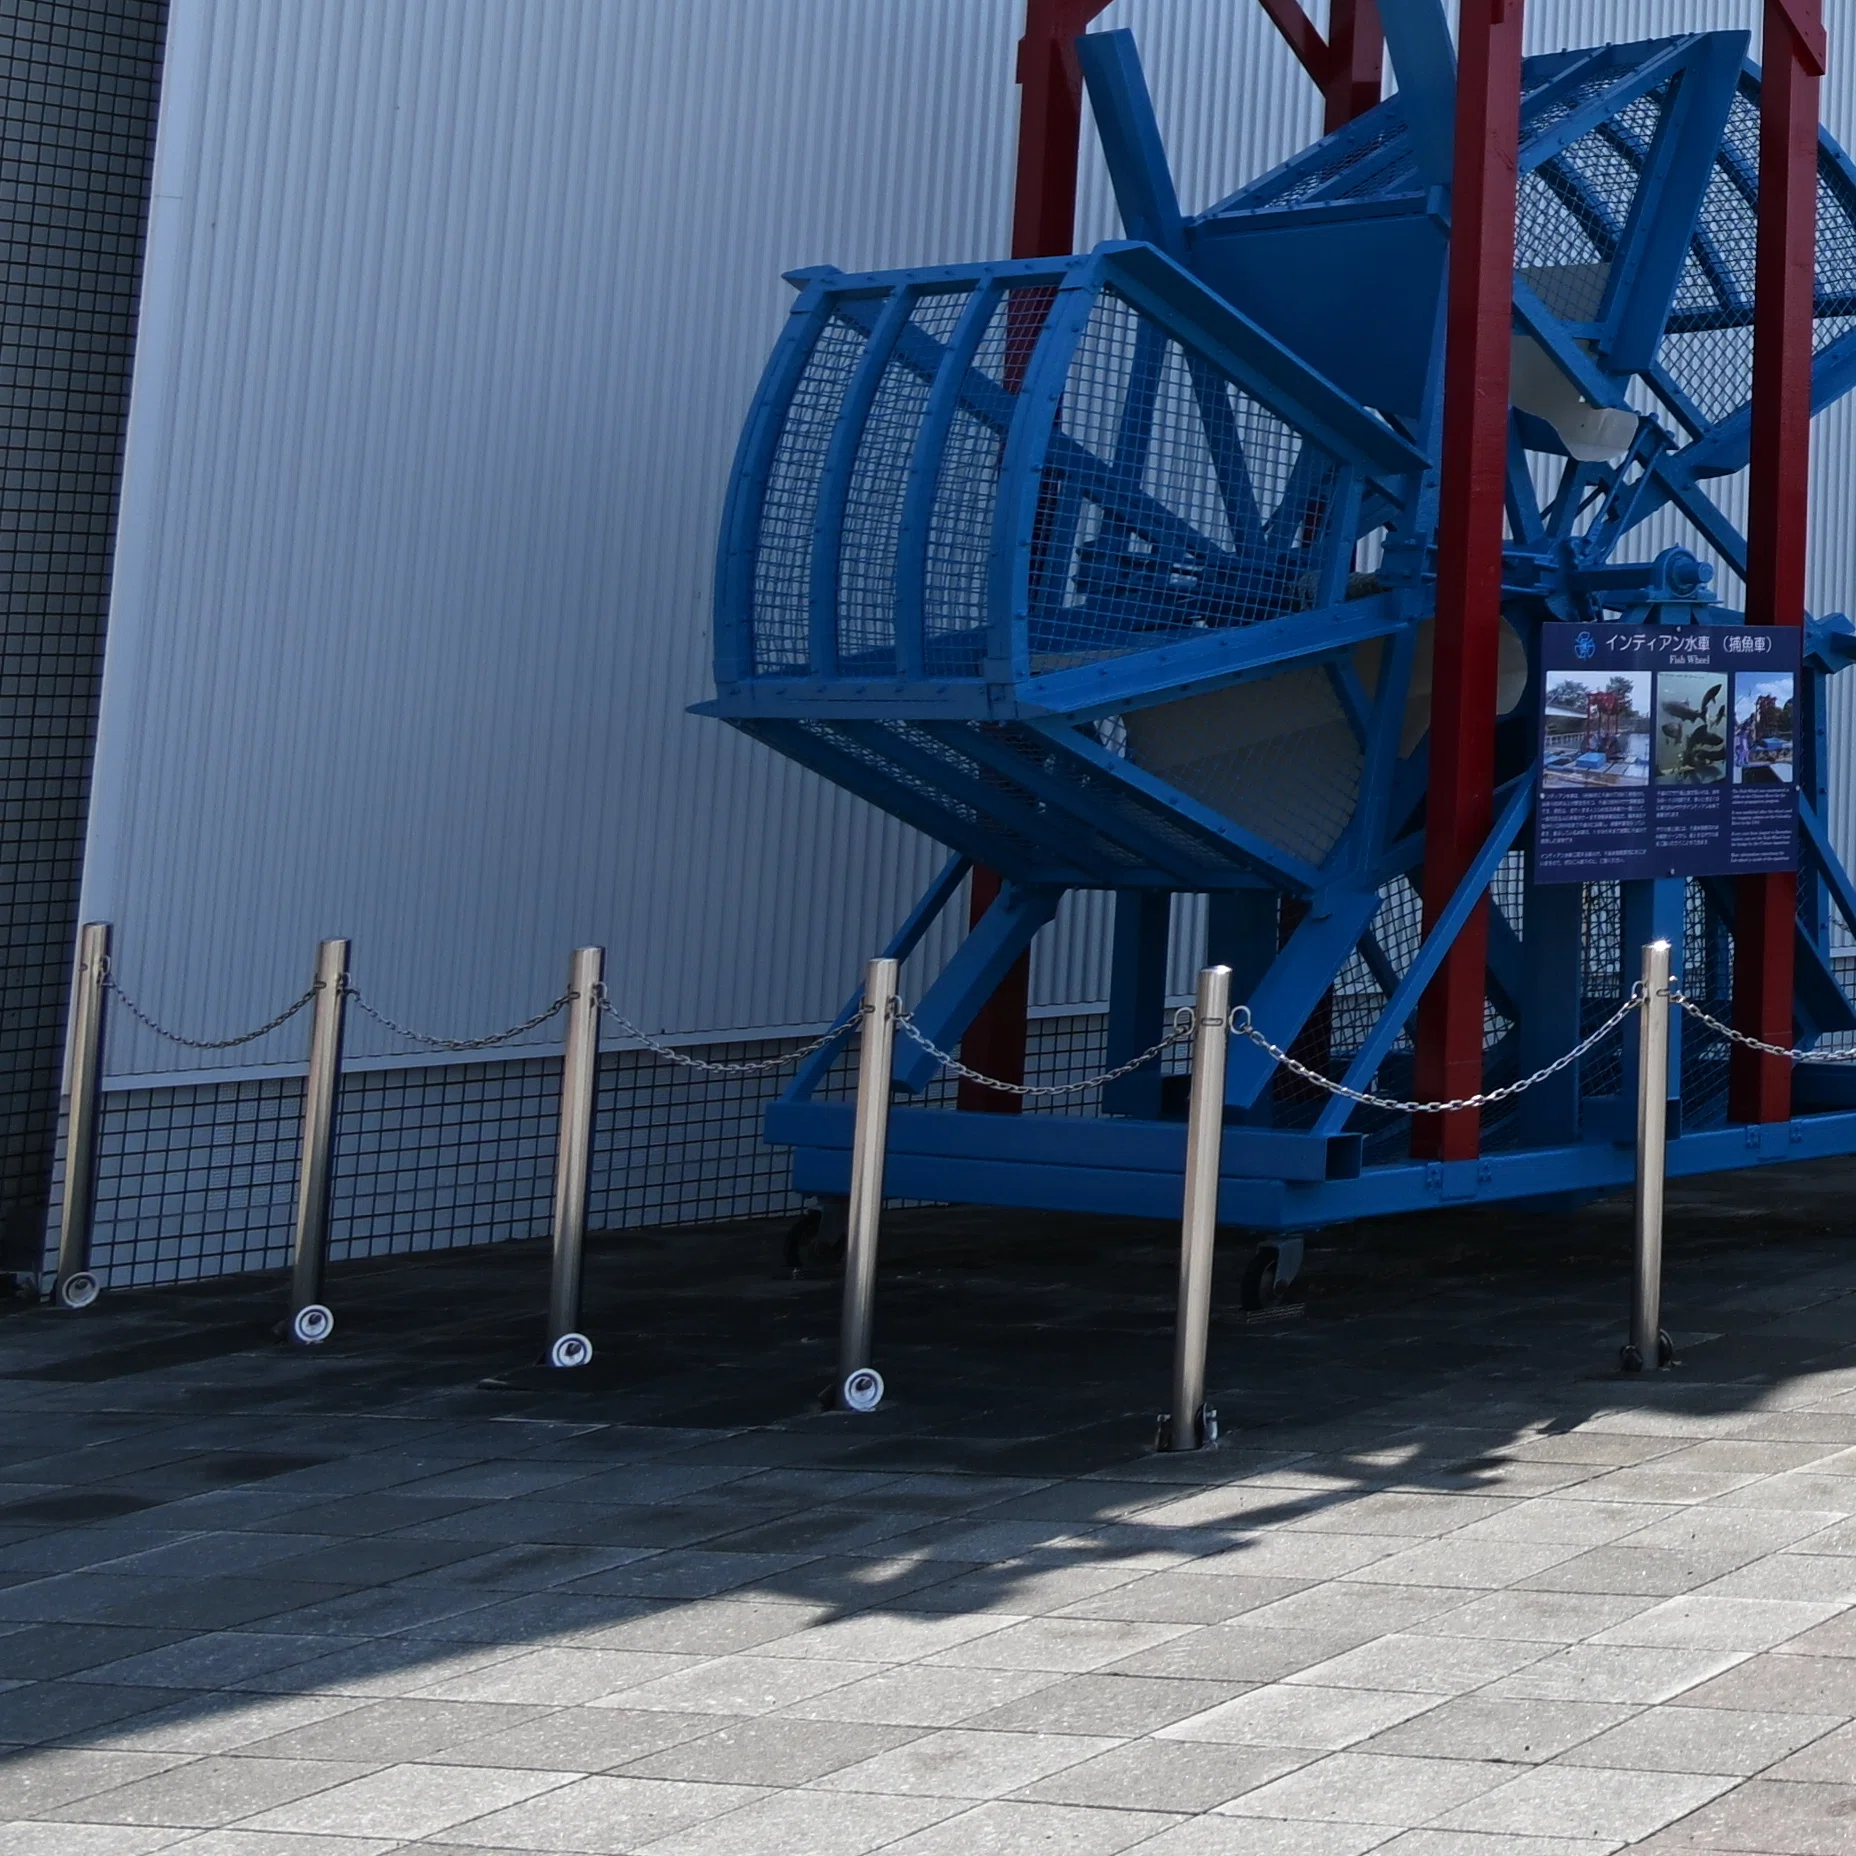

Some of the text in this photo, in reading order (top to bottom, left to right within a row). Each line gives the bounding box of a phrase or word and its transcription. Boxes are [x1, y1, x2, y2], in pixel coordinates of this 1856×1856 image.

[1606, 634, 1710, 652] インディアン水車
[1669, 655, 1710, 664] Fish Wheel
